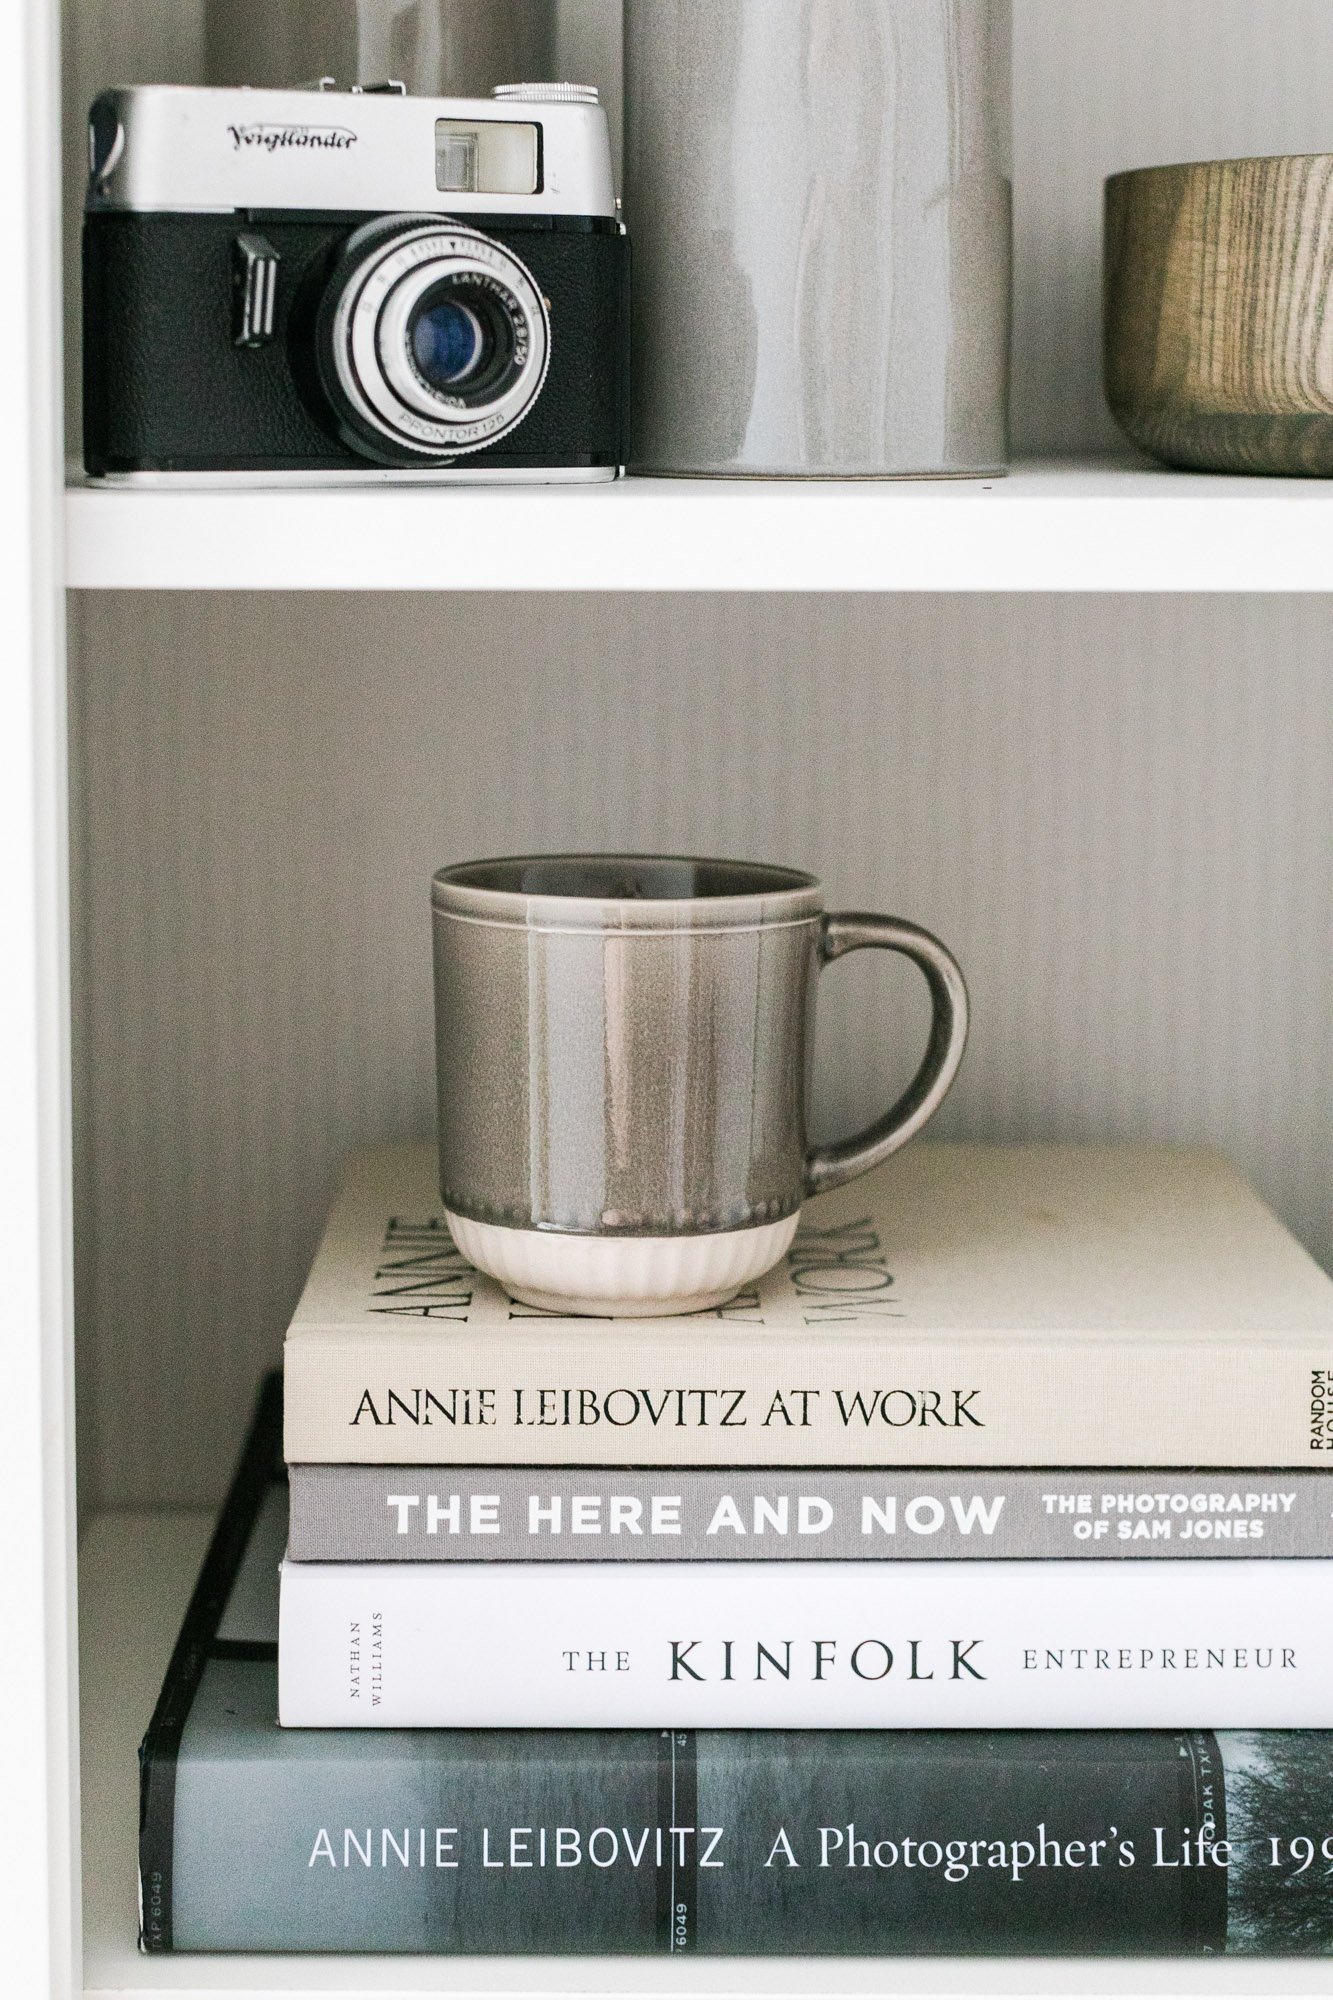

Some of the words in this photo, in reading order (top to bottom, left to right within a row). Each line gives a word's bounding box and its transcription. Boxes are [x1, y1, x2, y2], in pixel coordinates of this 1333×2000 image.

[399, 412, 478, 440] PRONTOR
[350, 1388, 496, 1426] ANNIE
[514, 1388, 747, 1427] LEIBOVITZ
[762, 1389, 820, 1427] AT
[832, 1389, 986, 1427] WORK
[1309, 1370, 1325, 1450] RANDOM
[386, 1495, 501, 1535] THE
[528, 1495, 682, 1535] HERE
[706, 1495, 834, 1535] AND
[861, 1495, 1006, 1535] NOW
[1042, 1494, 1092, 1514] THE
[1102, 1493, 1297, 1514] PHOTOGRAPHY
[1073, 1519, 1109, 1540] OF
[1118, 1519, 1171, 1540] SAM
[1180, 1519, 1264, 1539] JONES
[350, 1622, 360, 1698] NATHAN
[372, 1612, 382, 1706] WILLIAMS
[562, 1651, 630, 1671] THE
[668, 1640, 988, 1681] KINFOLK
[1024, 1649, 1297, 1669] ENTREPRENEUR
[309, 1828, 459, 1868] ANNIE
[483, 1827, 724, 1868] LEIBOVITZ
[764, 1827, 801, 1867] A
[1152, 1821, 1233, 1868] Life
[151, 1872, 163, 1917] 6049
[676, 1903, 687, 1946] 6049
